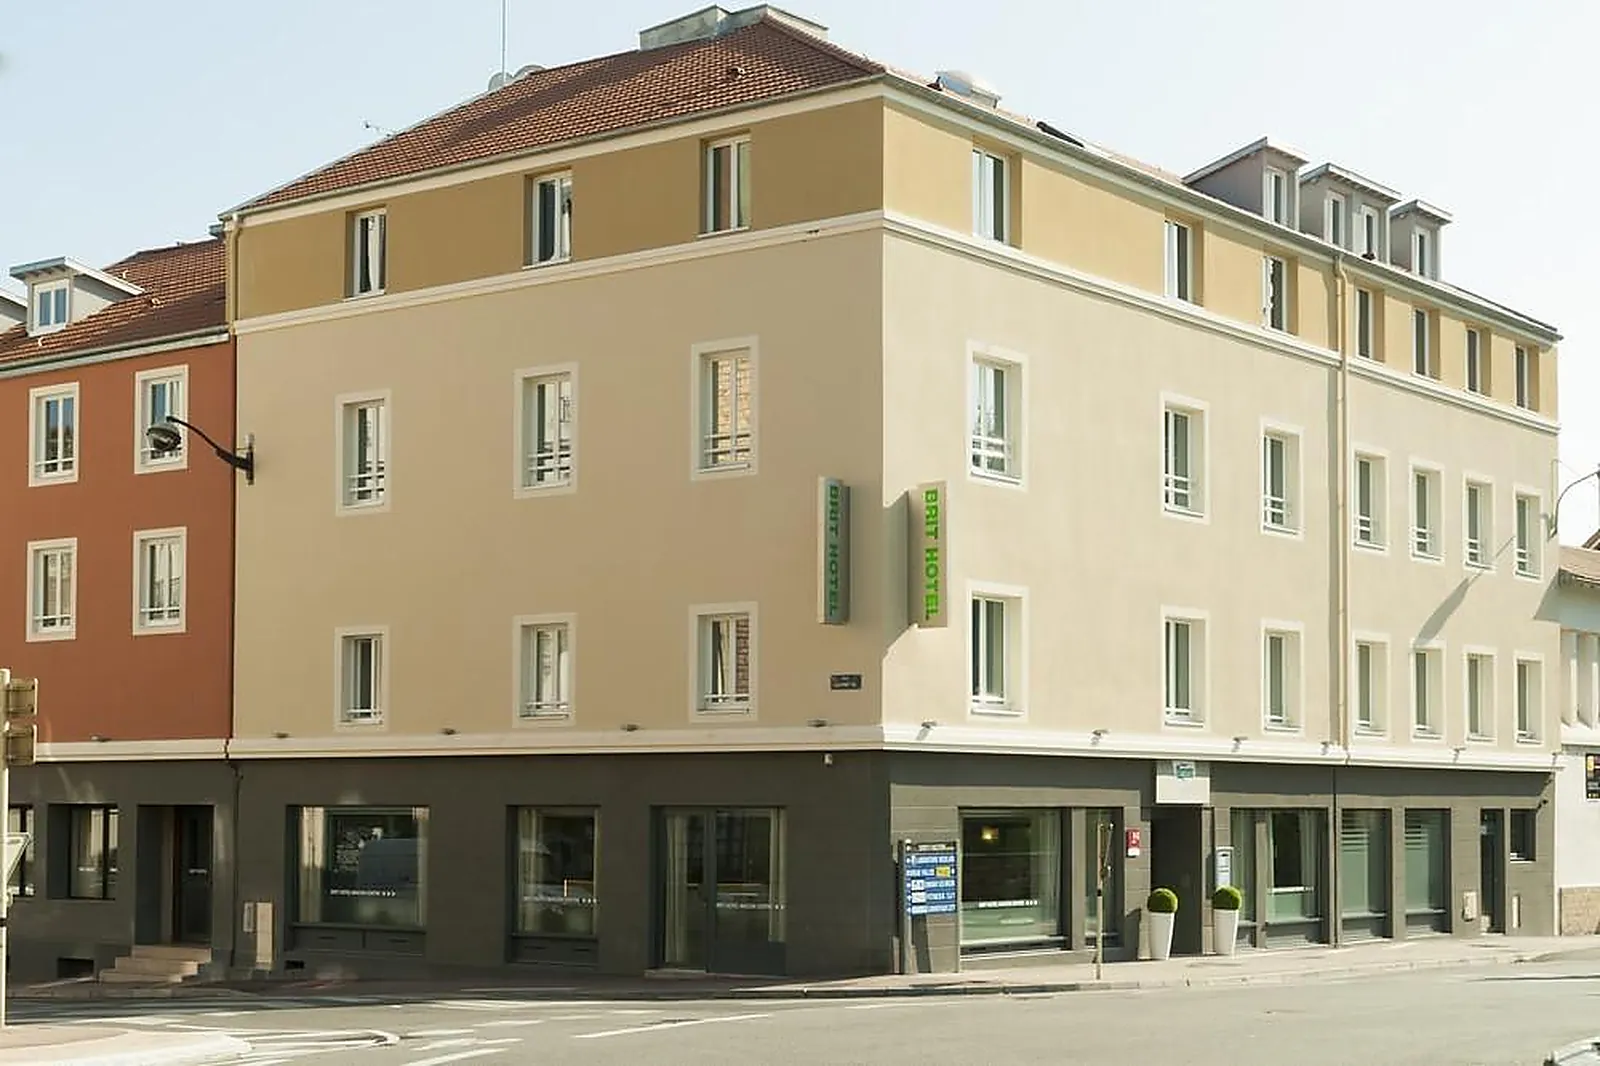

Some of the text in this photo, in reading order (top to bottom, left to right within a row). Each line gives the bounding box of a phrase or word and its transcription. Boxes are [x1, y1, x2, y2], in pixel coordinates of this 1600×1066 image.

[829, 544, 838, 616] HOTEL
[925, 489, 938, 621] BRIT HOTEL
